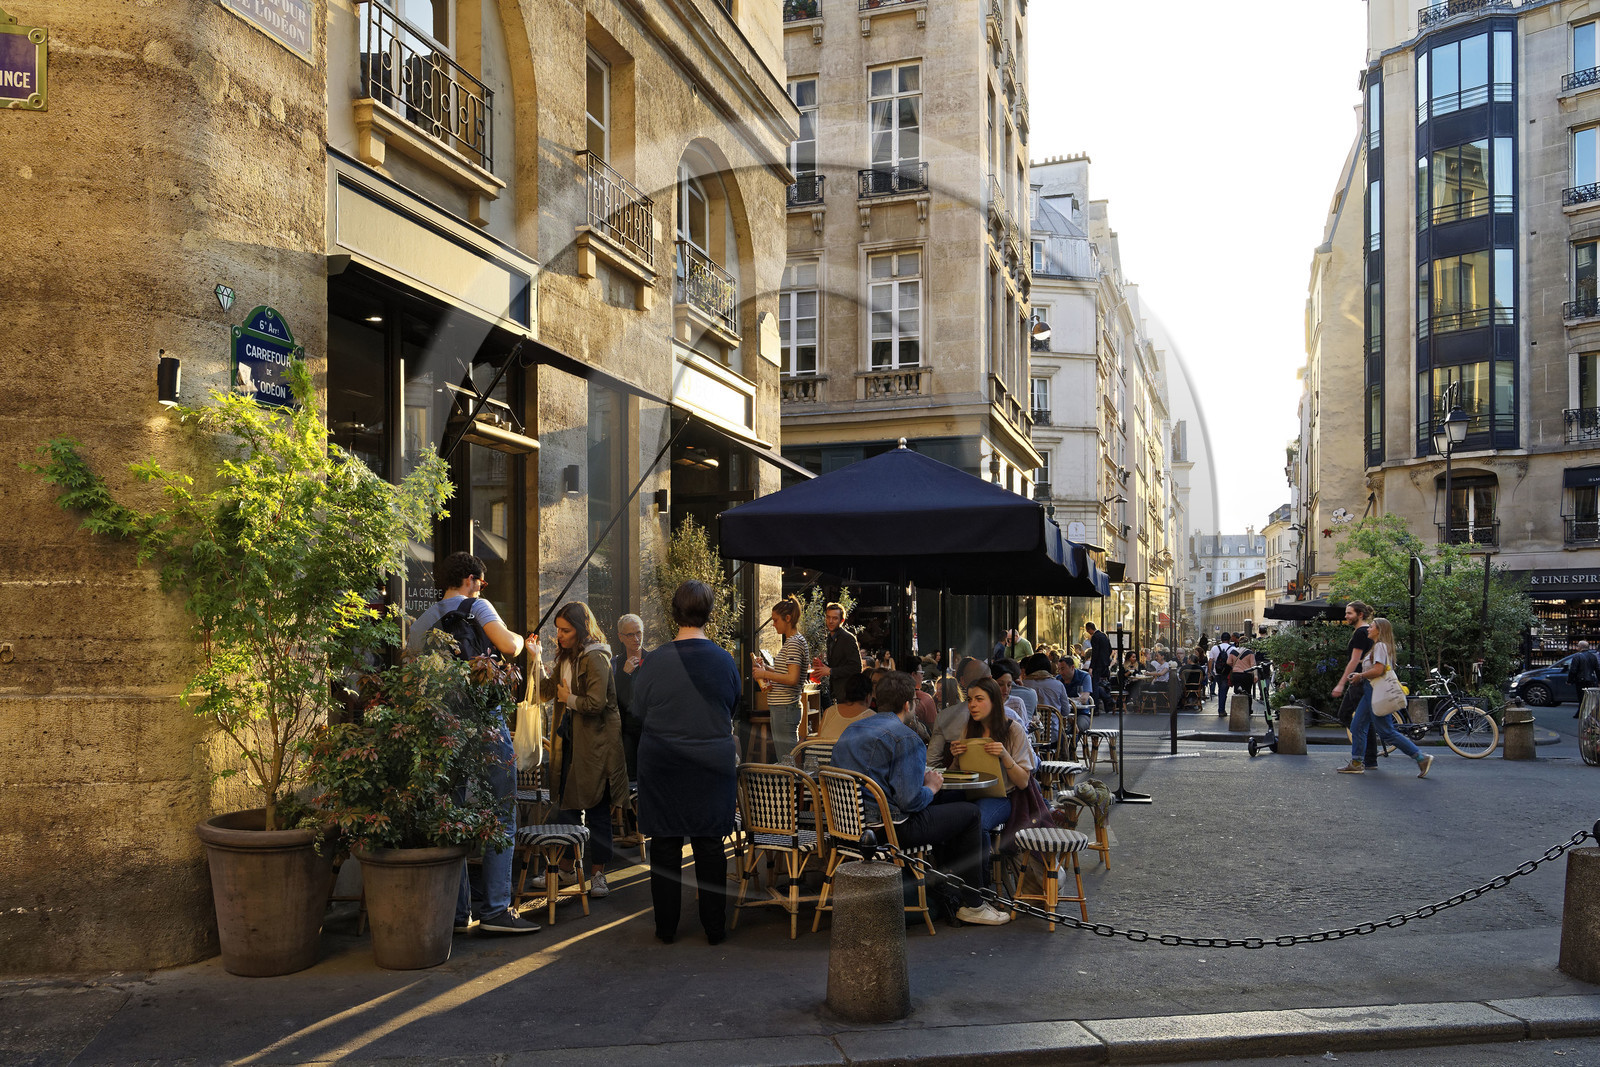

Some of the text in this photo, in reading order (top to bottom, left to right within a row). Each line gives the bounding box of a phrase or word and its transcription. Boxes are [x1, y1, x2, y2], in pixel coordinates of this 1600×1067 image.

[245, 343, 291, 368] CARREFOUR
[266, 368, 272, 377] DE
[1531, 574, 1600, 585] & FINE SPIR
[408, 587, 418, 598] LA
[405, 600, 438, 611] AUTREM
